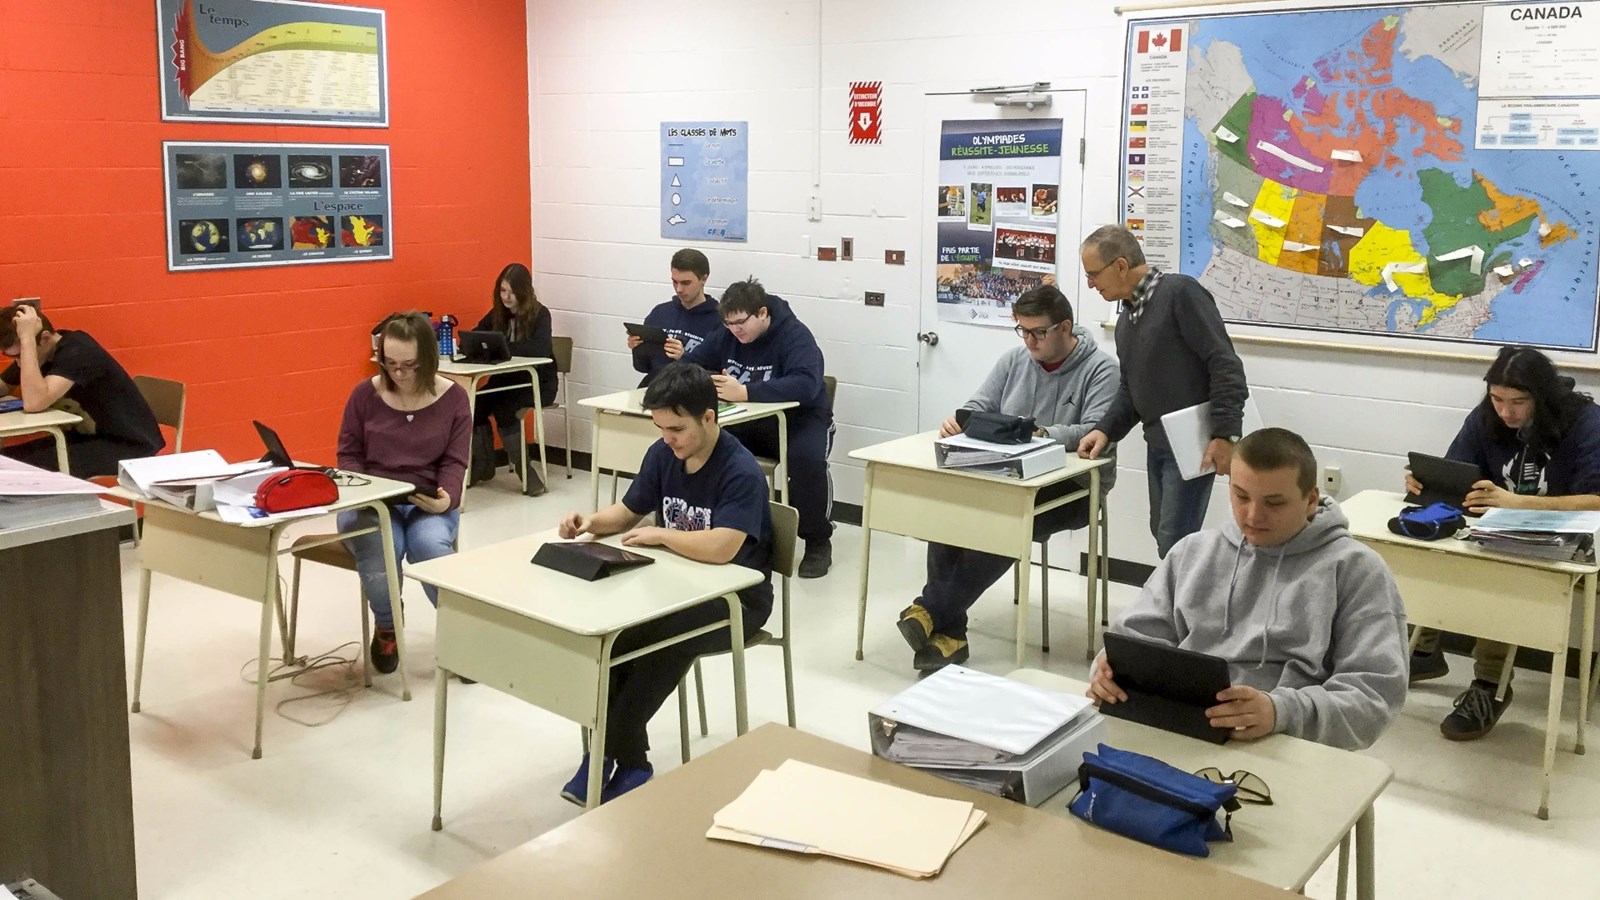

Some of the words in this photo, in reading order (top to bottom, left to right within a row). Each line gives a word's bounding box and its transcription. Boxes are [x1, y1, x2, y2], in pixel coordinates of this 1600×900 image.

[199, 3, 216, 15] Le
[1510, 6, 1583, 21] CANADA
[209, 14, 250, 29] temps
[178, 39, 186, 60] BANG
[667, 128, 679, 137] LES
[680, 128, 706, 137] CLASSES
[708, 128, 718, 137] DE
[719, 128, 738, 137] MOTS
[972, 133, 1026, 146] OLYMPIADES
[951, 143, 1050, 156] RÉUSSITE-JEUNESSE
[313, 201, 364, 213] L'espace
[941, 246, 957, 254] FAIS
[957, 246, 980, 254] PARTIE
[940, 254, 950, 262] DE
[1313, 295, 1364, 305] UNIS
